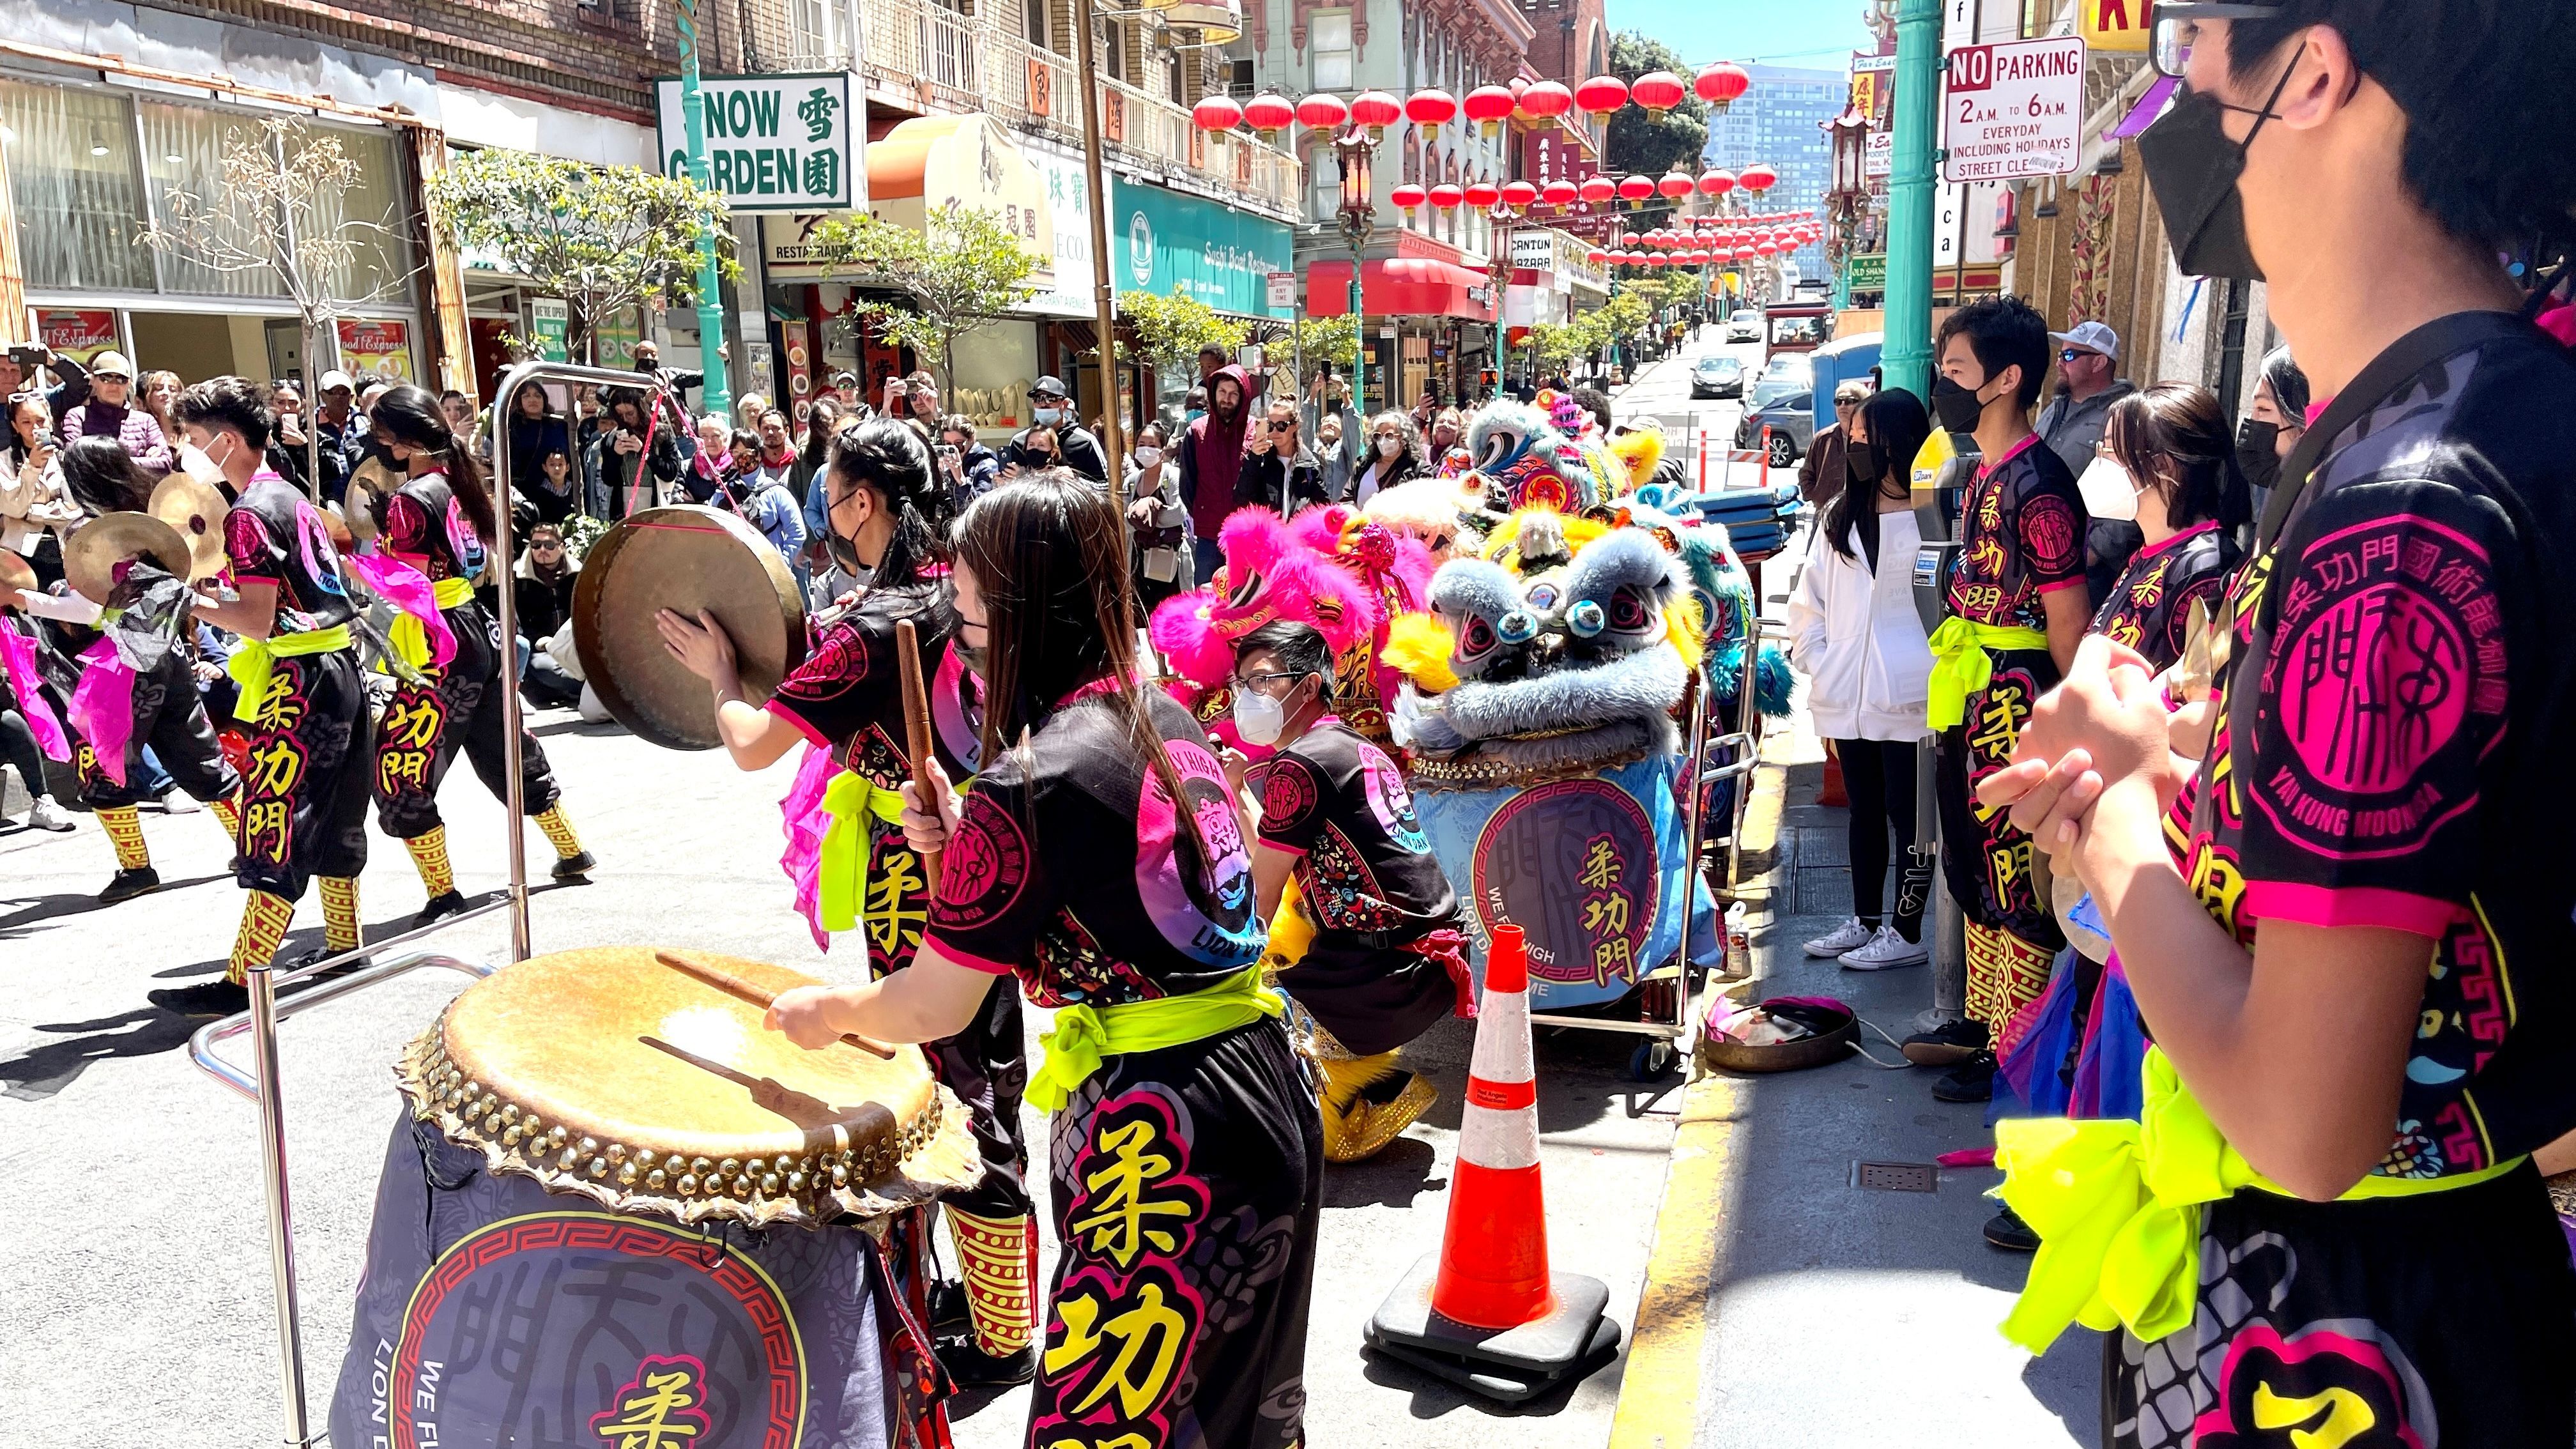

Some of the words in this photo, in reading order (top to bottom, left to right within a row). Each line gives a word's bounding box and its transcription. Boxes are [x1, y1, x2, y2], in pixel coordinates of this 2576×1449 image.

[1952, 50, 1987, 86] NO
[1997, 50, 2078, 81] PARKING
[683, 90, 781, 138] NOW
[1960, 98, 1974, 123] 2
[1975, 109, 1999, 123] A.M.
[2009, 106, 2020, 116] TO
[2028, 93, 2042, 118] 6
[2044, 102, 2067, 116] A.M.
[1954, 142, 2011, 158] INCLUDING
[2016, 137, 2071, 153] HOLIDAYS
[1982, 123, 2042, 140] EVERYDAY
[670, 148, 798, 195] GRDEN
[1958, 161, 2002, 177] STREET
[2007, 157, 2064, 172] CLEG
[1204, 241, 1227, 272] Sushi
[1229, 245, 1246, 272] Boat
[1248, 250, 1280, 276] Restaurant
[1512, 238, 1551, 250] CANTON
[1514, 257, 1551, 269] AZAAR
[1852, 268, 1865, 277] OLD
[535, 305, 551, 317] WE'RE
[1043, 295, 1063, 307] GRANT
[1064, 296, 1086, 310] AVENUE
[59, 328, 114, 351] Express
[340, 335, 358, 349] ood
[365, 335, 404, 354] Express
[382, 699, 440, 795] 功門
[246, 673, 301, 864] 柔功門
[1186, 750, 1222, 782] HIGH
[2290, 796, 2349, 837] KUNG
[2354, 804, 2419, 838] MOON
[1898, 845, 1934, 916] FILA
[863, 851, 927, 956] 柔
[1460, 895, 1482, 937] LION
[1581, 840, 1636, 986] 柔功門
[1191, 924, 1241, 958] LION
[1488, 886, 1505, 914] WE
[1522, 938, 1555, 965] HIGH
[1040, 1120, 1191, 1449] 柔功
[371, 1337, 394, 1424] LION
[416, 1360, 444, 1413] WE
